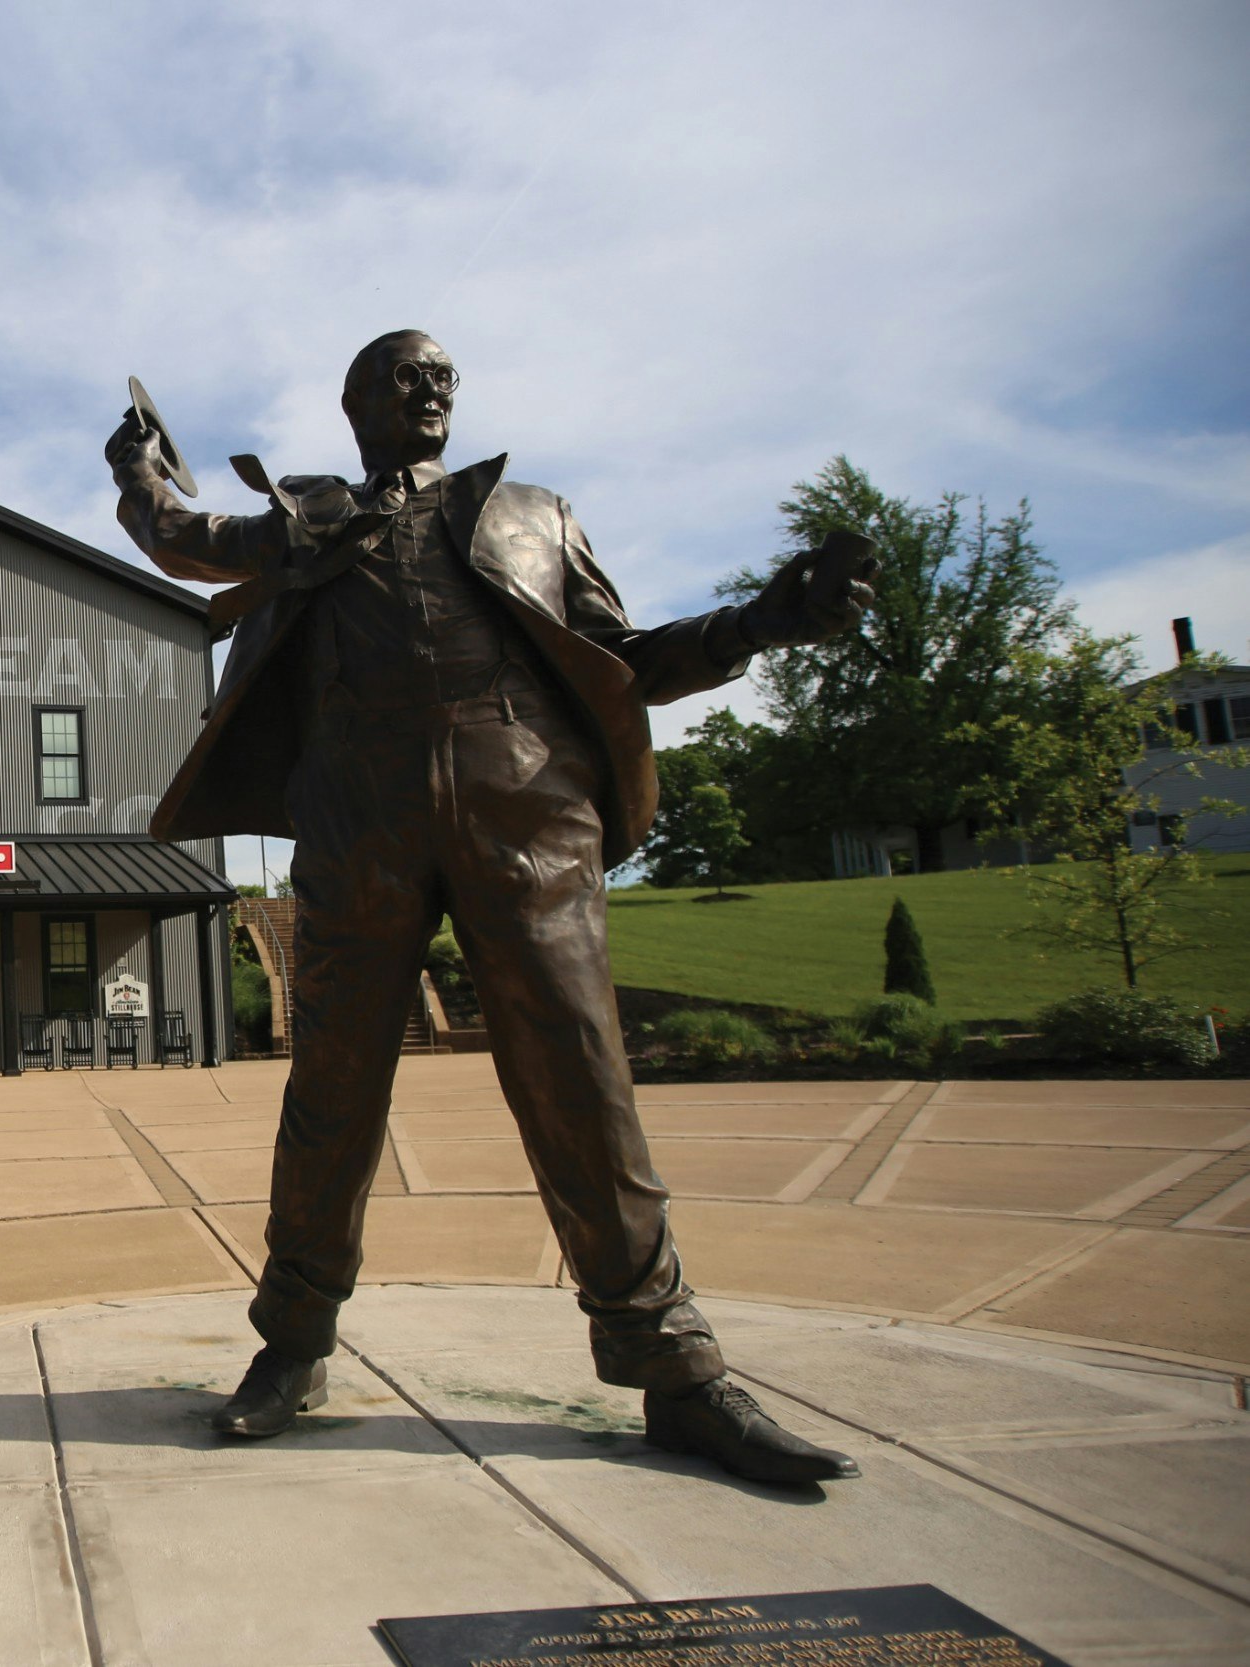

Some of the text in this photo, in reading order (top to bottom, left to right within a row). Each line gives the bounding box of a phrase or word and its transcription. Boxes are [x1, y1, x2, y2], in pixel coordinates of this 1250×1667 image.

[593, 1604, 763, 1629] JIM BEAM
[528, 1632, 600, 1647] AUGUST
[690, 1620, 791, 1637] DECEMBER
[730, 1641, 791, 1656] BEAM
[791, 1638, 838, 1650] WAS
